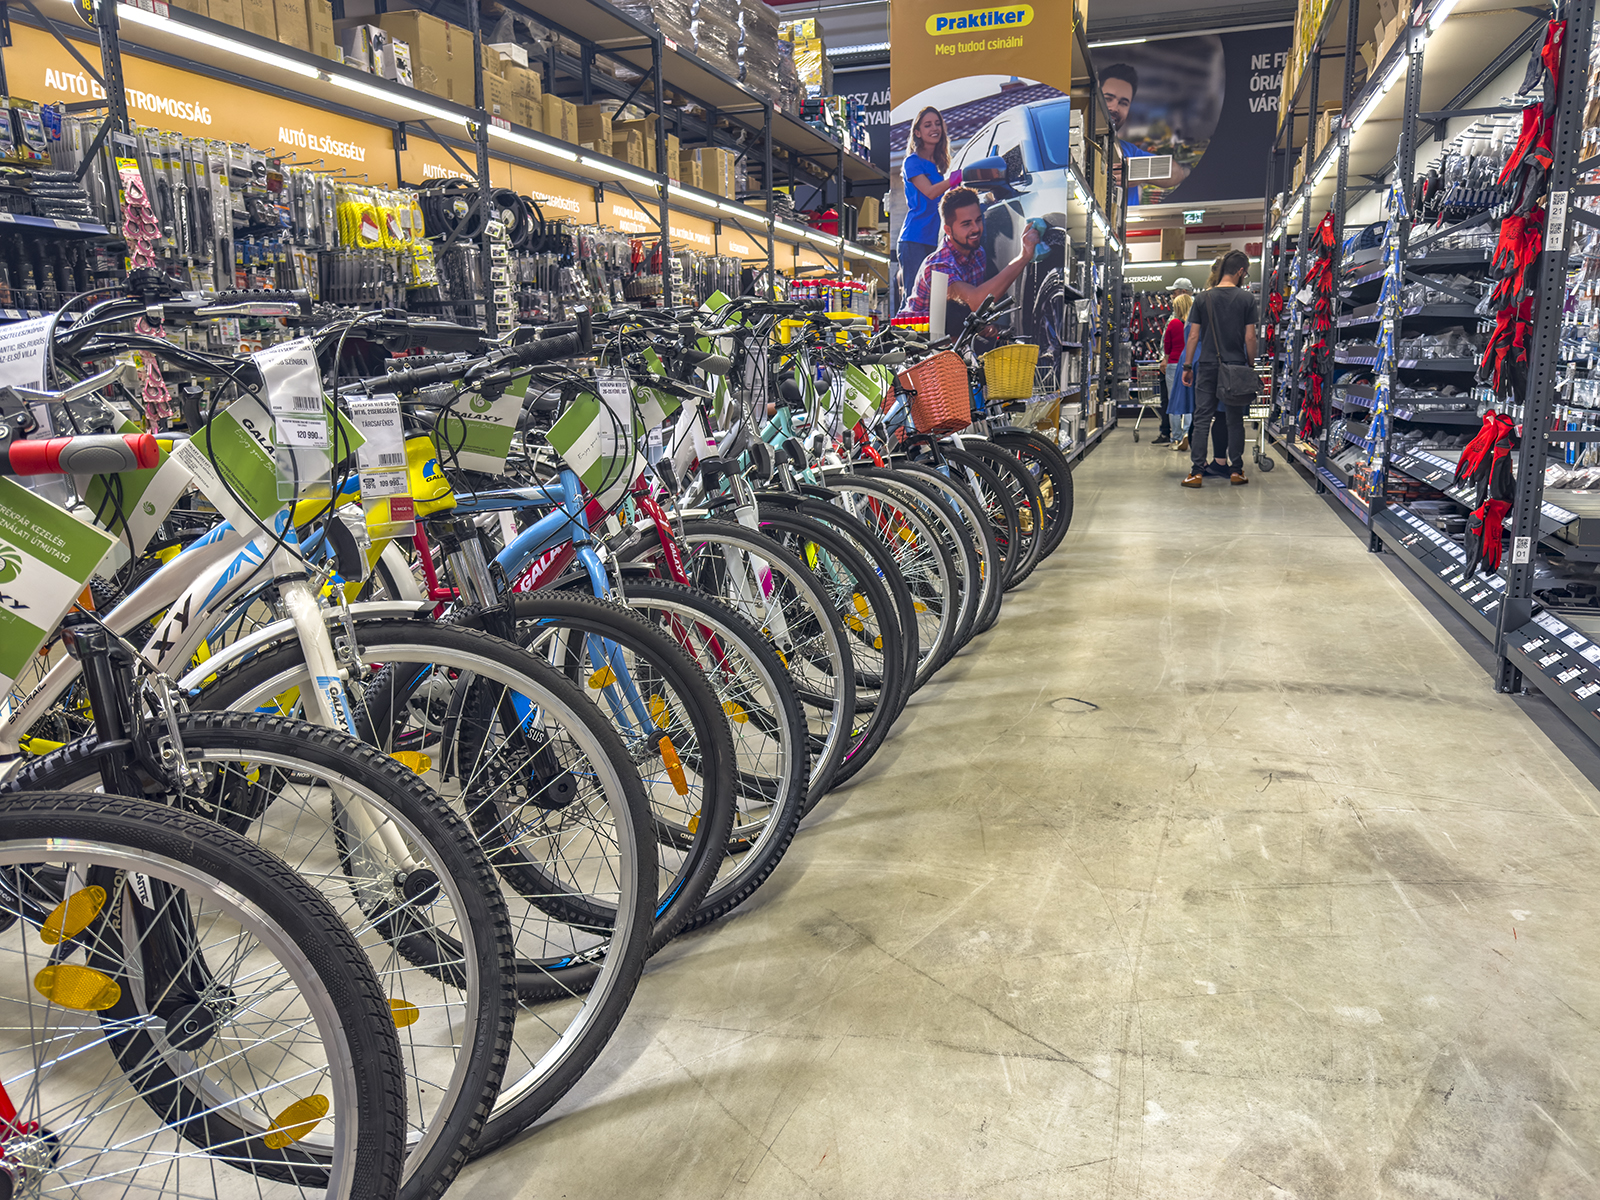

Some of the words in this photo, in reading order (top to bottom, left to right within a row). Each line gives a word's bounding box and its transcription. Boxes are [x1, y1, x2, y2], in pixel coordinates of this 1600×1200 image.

[936, 10, 1025, 31] Praktiker
[935, 43, 956, 56] Meg
[957, 39, 985, 54] tudod
[987, 35, 1023, 51] csinálni
[1251, 53, 1271, 70] NE
[45, 68, 88, 96] AUTÓ
[278, 127, 306, 148] AUTÓ
[1552, 207, 1562, 215] 21
[450, 411, 504, 423] GALAXY
[296, 430, 307, 439] 120
[307, 431, 319, 440] 990
[30, 522, 67, 549] KEZELÉSI
[30, 535, 71, 564] ÚTMUTATÓ
[669, 542, 685, 578] GALAXY
[1516, 550, 1526, 558] 01
[520, 541, 568, 593] GALA
[20, 684, 47, 710] TRAIL
[329, 686, 350, 735] GALAXY
[527, 728, 545, 743] SUS
